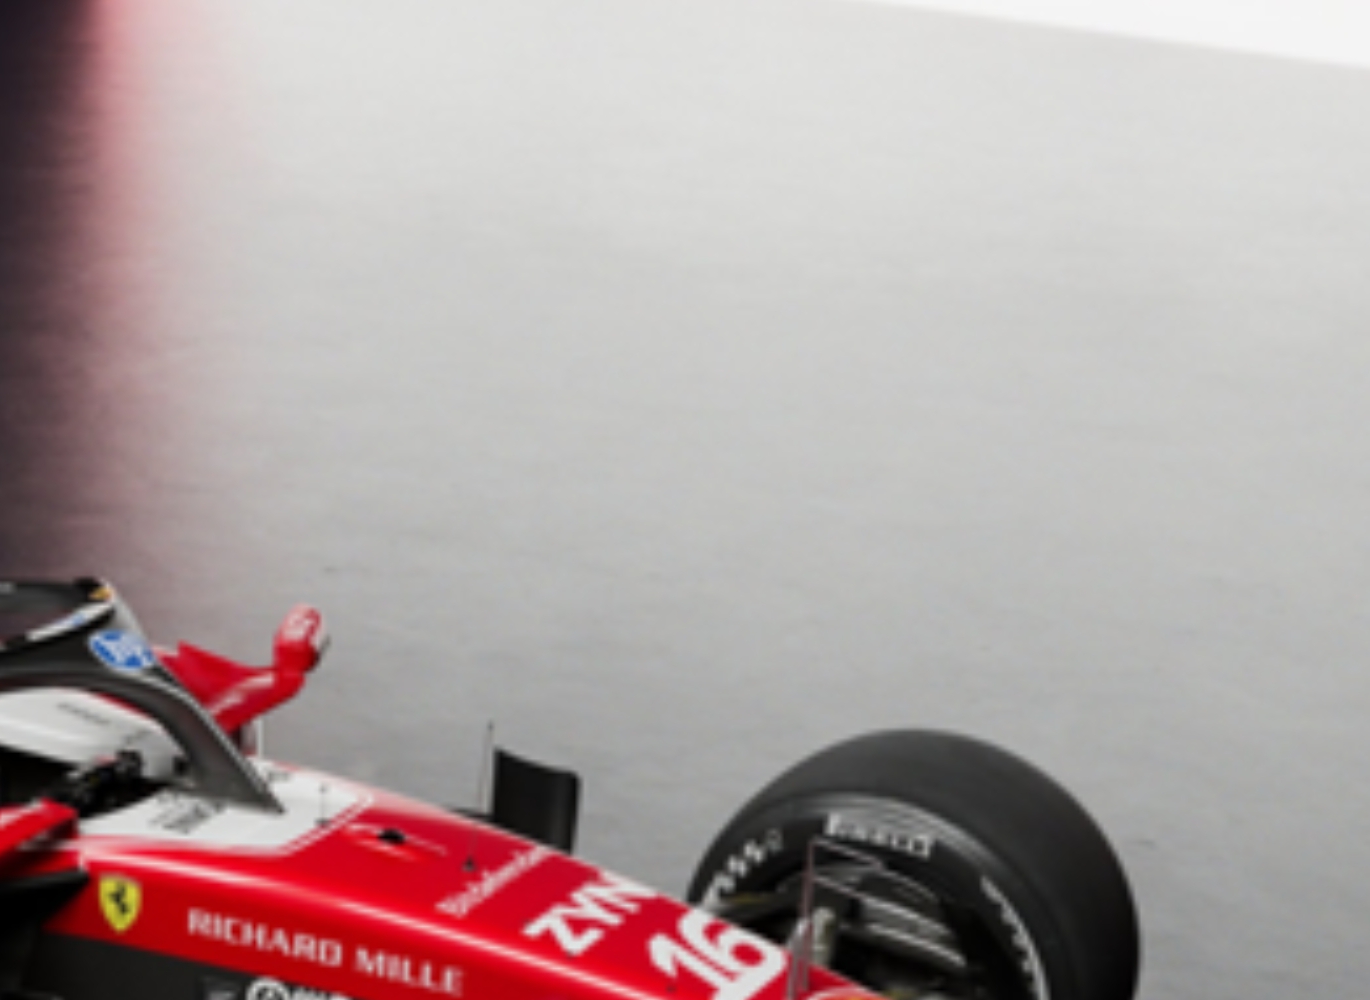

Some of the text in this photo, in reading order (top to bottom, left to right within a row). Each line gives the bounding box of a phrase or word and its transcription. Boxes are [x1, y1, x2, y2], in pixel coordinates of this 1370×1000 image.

[187, 906, 464, 998] RICHARD MILLE
[520, 866, 660, 958] ZYN
